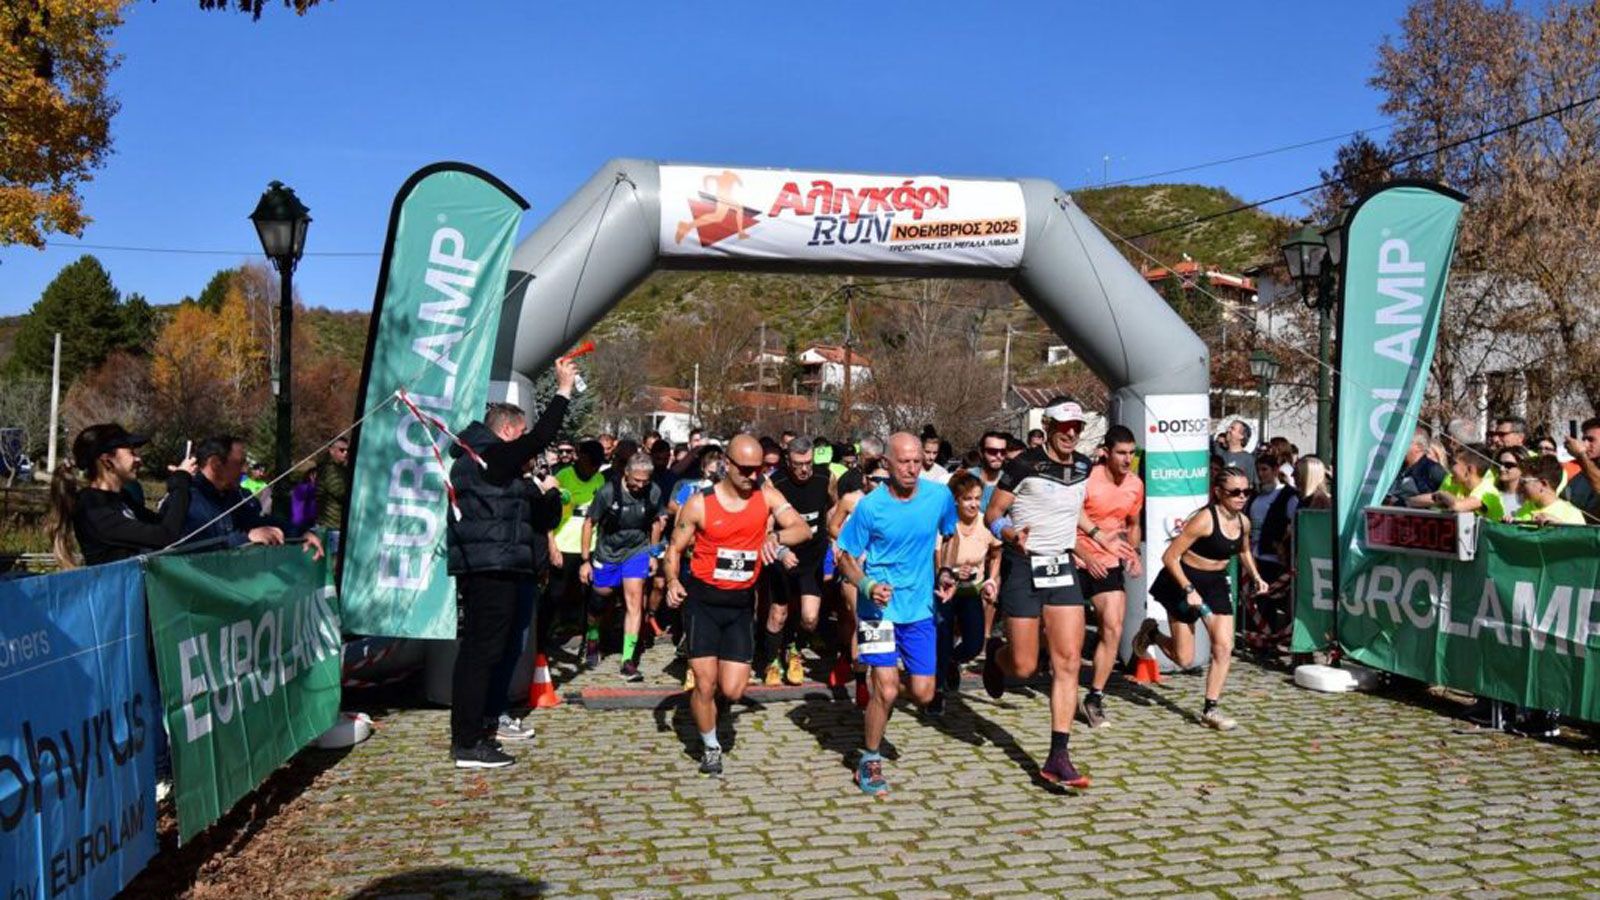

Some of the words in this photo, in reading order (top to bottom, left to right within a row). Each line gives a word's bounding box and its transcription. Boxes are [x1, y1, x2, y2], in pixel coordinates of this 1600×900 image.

[768, 180, 949, 223] Αλιγκάρι
[807, 213, 895, 246] RUN
[896, 224, 982, 239] ΝΟΕΜΒΡΙΟΣ
[985, 220, 1018, 234] 2025
[377, 226, 480, 591] EUROLAMP
[1151, 467, 1208, 479] EUROLAMP
[729, 560, 745, 569] 39
[1046, 565, 1059, 575] 93
[865, 630, 880, 640] 95
